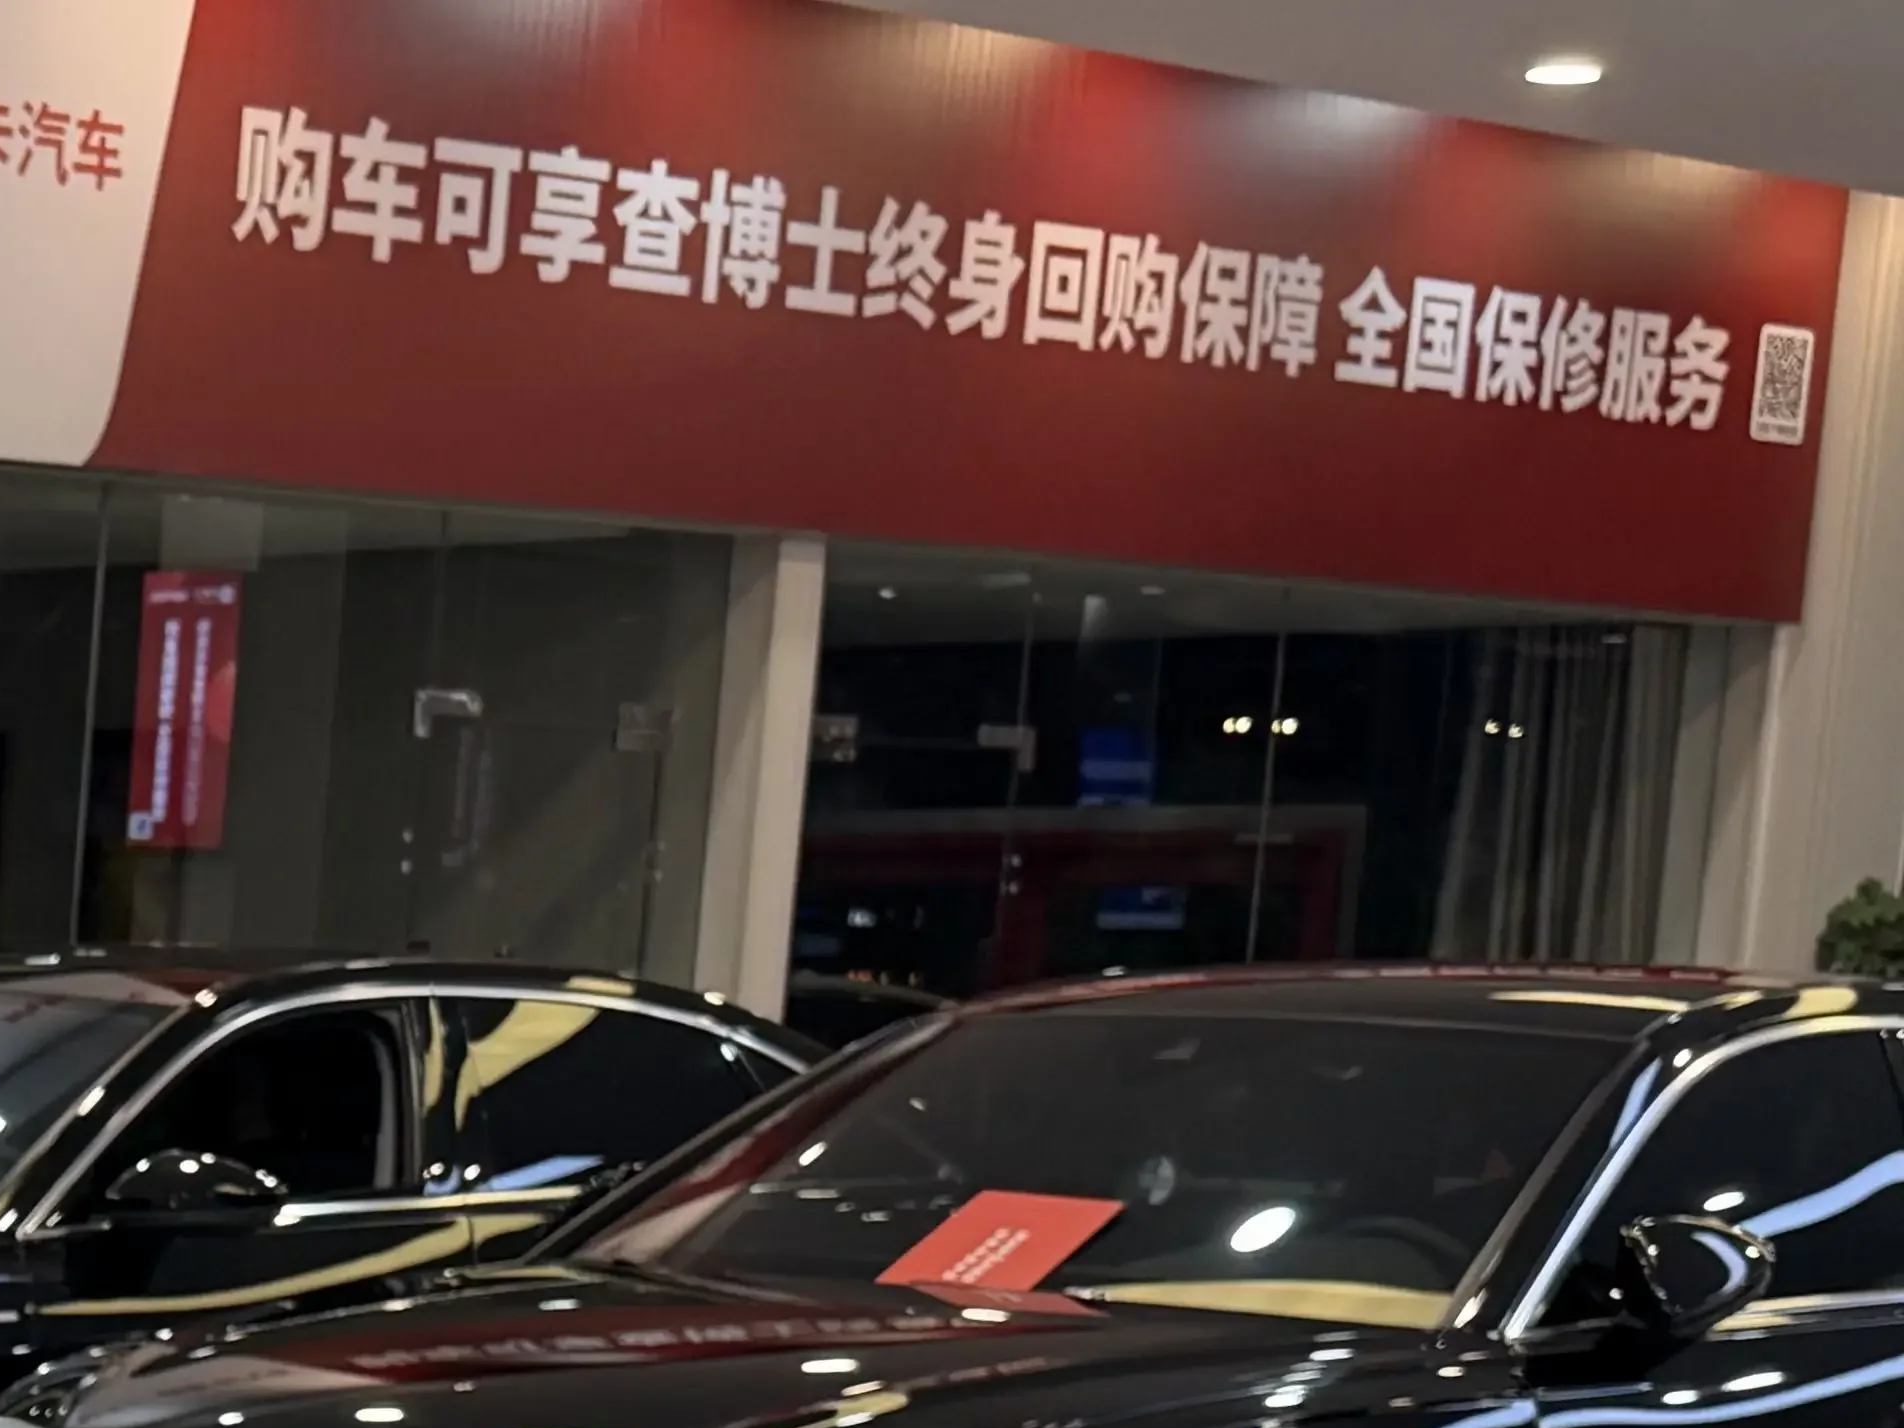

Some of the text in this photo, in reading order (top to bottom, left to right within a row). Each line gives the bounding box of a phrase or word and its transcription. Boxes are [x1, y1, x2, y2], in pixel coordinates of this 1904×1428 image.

[232, 105, 1730, 430] 购车可享查博士终身回购保障 全国保修服务
